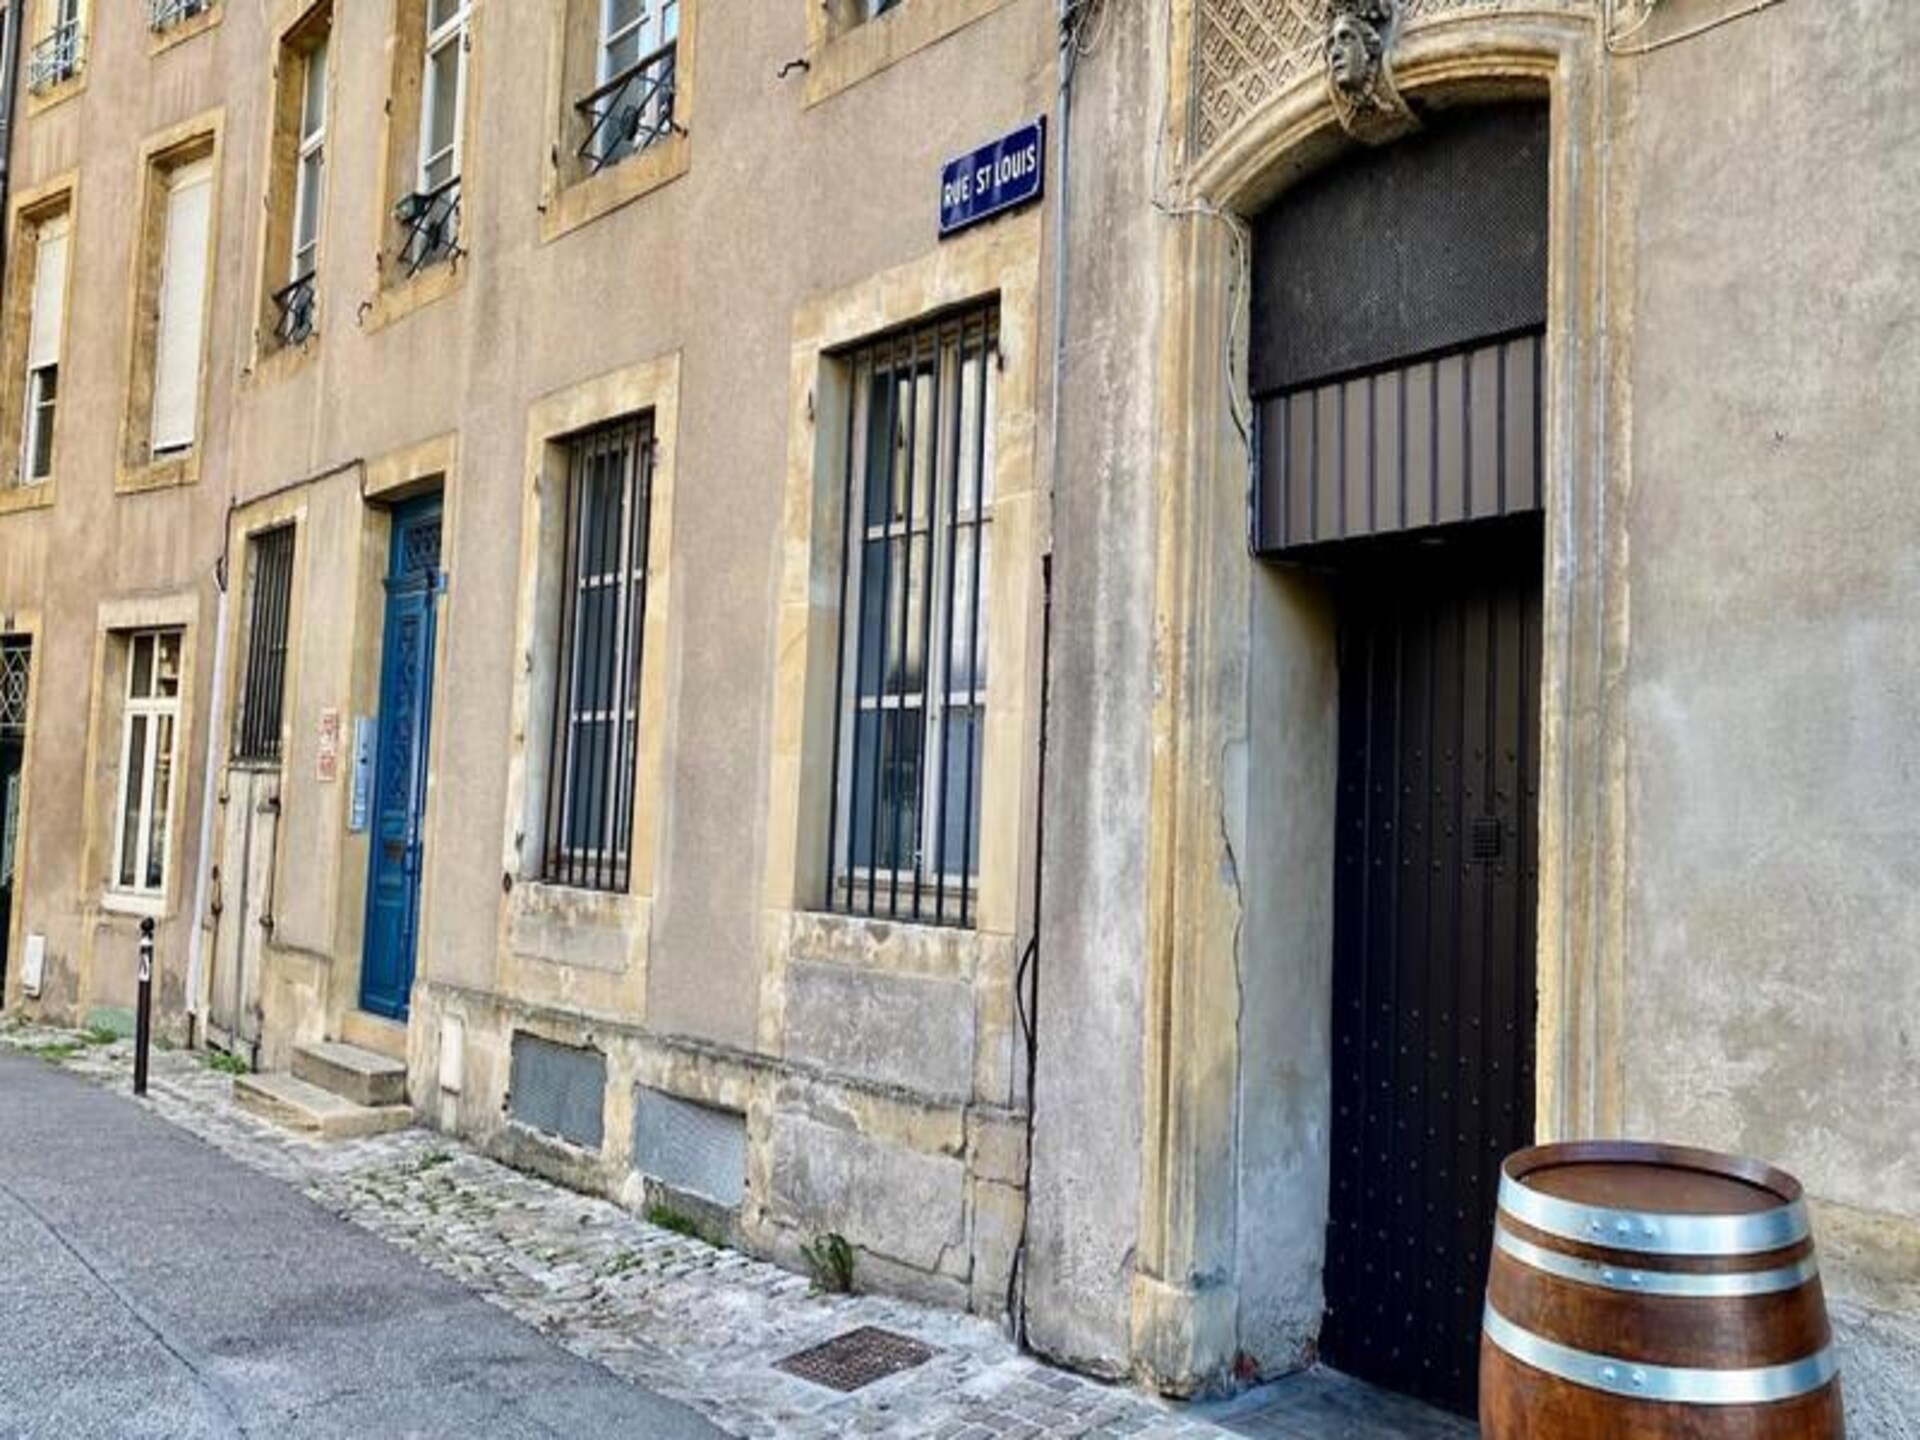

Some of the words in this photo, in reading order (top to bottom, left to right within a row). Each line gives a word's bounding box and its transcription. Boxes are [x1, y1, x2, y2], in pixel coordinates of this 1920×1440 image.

[943, 175, 969, 206] RUE
[976, 164, 992, 194] ST
[994, 143, 1035, 187] LOUIS
